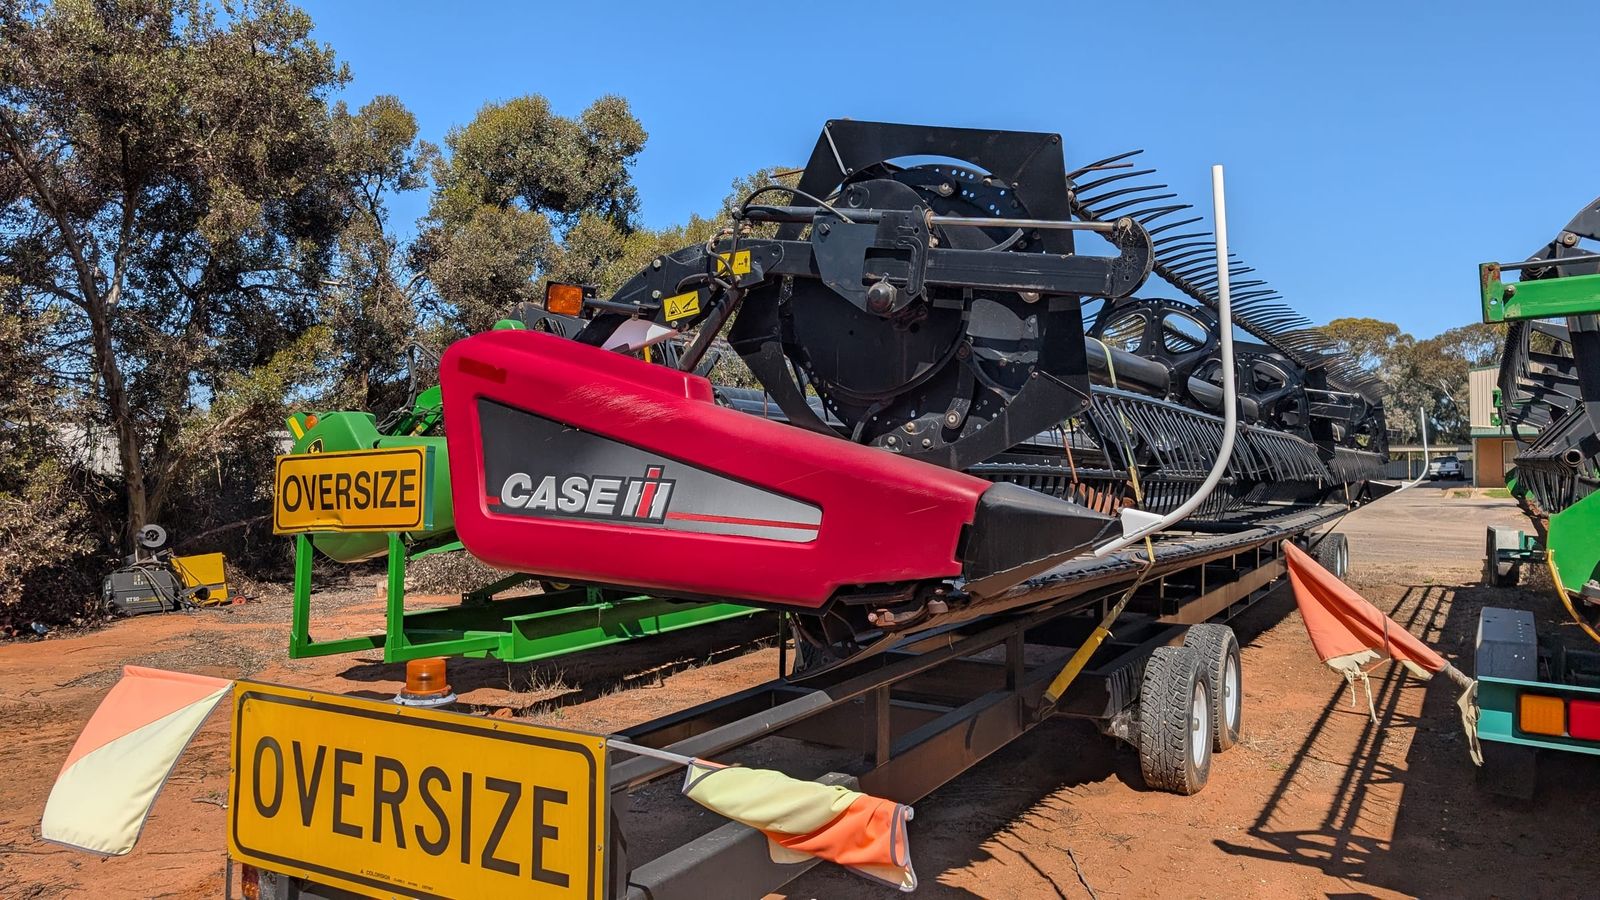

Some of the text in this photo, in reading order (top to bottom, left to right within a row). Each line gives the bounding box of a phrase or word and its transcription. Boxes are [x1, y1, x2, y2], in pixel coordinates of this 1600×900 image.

[282, 469, 416, 512] OVERSIZE
[500, 472, 622, 515] CASE
[252, 735, 570, 888] OVERSIZE
